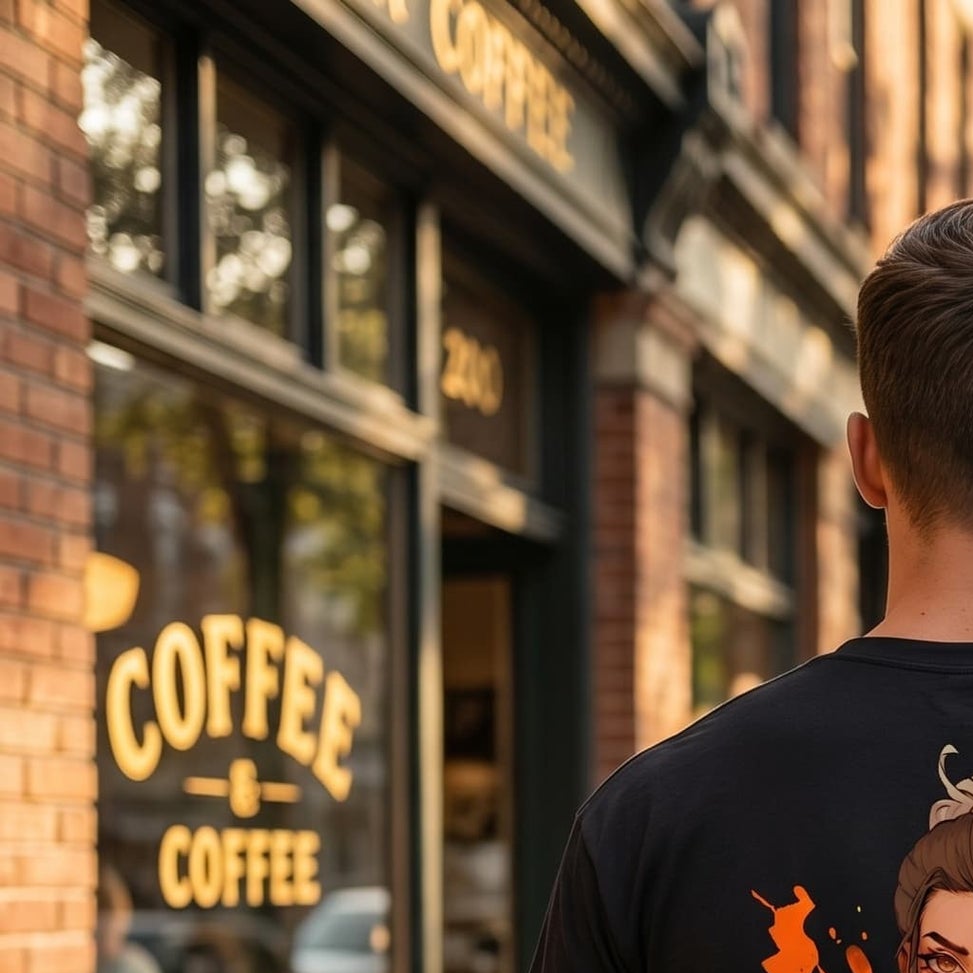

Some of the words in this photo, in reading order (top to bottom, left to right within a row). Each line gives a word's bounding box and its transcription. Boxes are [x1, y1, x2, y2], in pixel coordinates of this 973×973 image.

[430, 0, 575, 173] COFFEE
[106, 614, 361, 801] COFFEE
[158, 824, 321, 908] COFFEE
